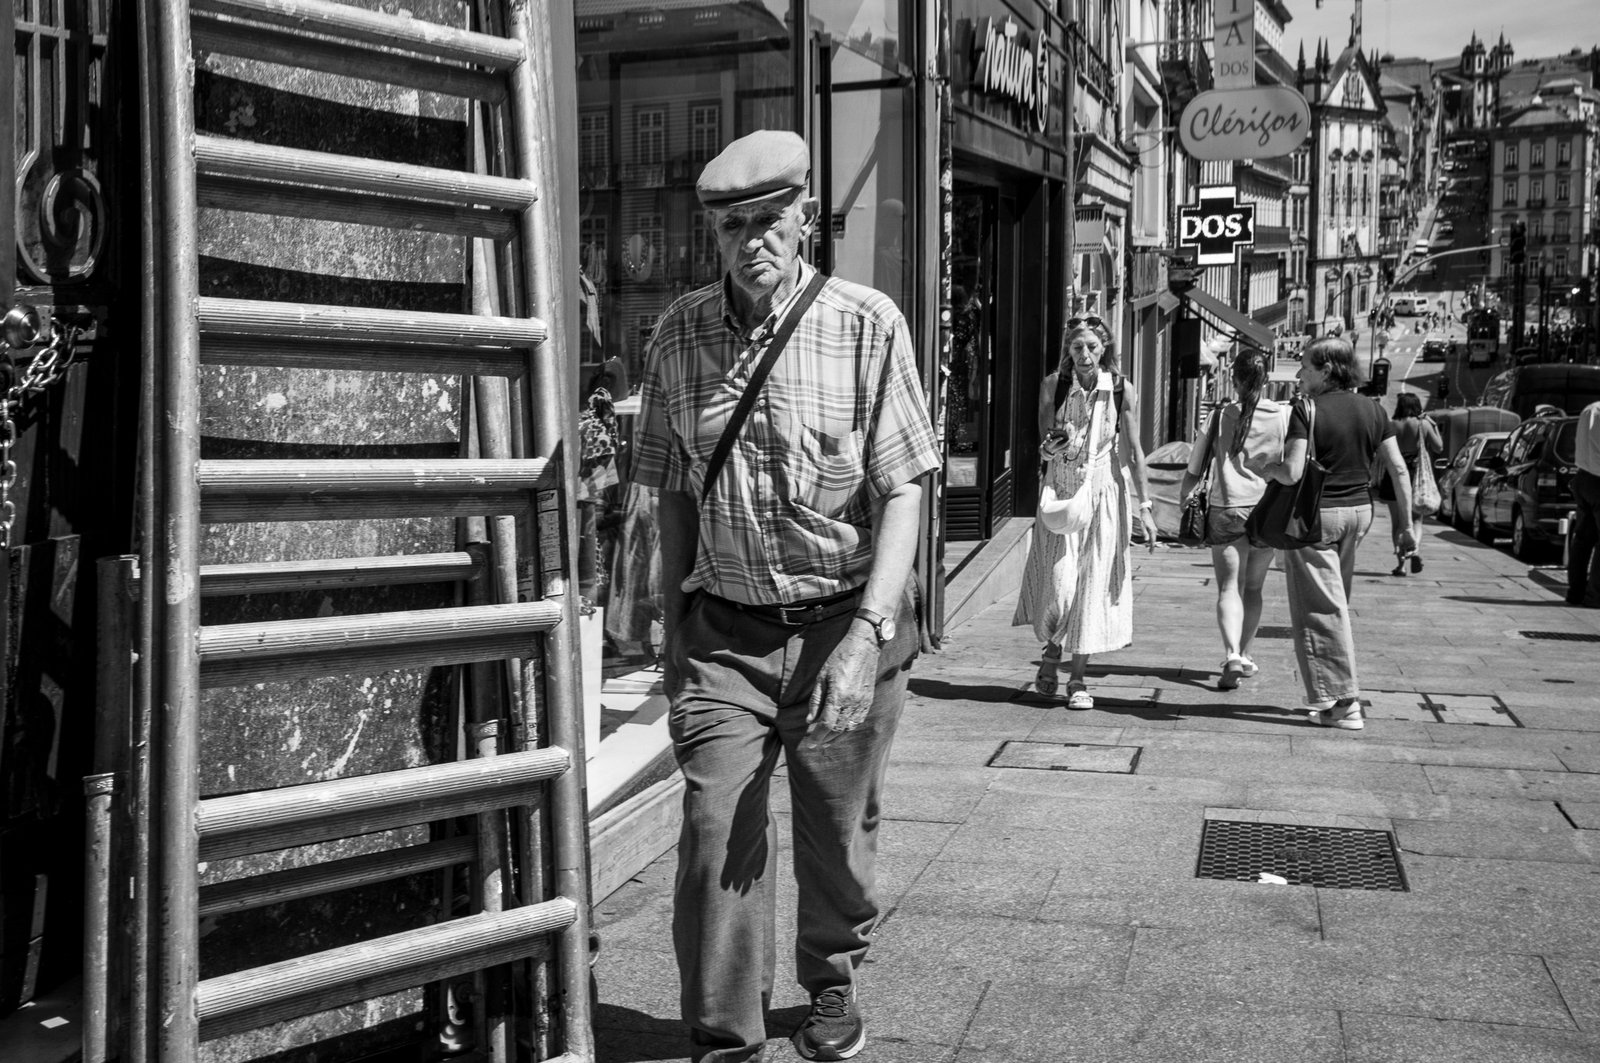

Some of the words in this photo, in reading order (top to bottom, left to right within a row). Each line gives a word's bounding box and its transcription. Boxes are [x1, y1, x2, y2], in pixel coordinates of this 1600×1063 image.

[1220, 61, 1249, 77] DOS
[1190, 103, 1303, 147] Clérigos
[1180, 213, 1243, 238] DOS
